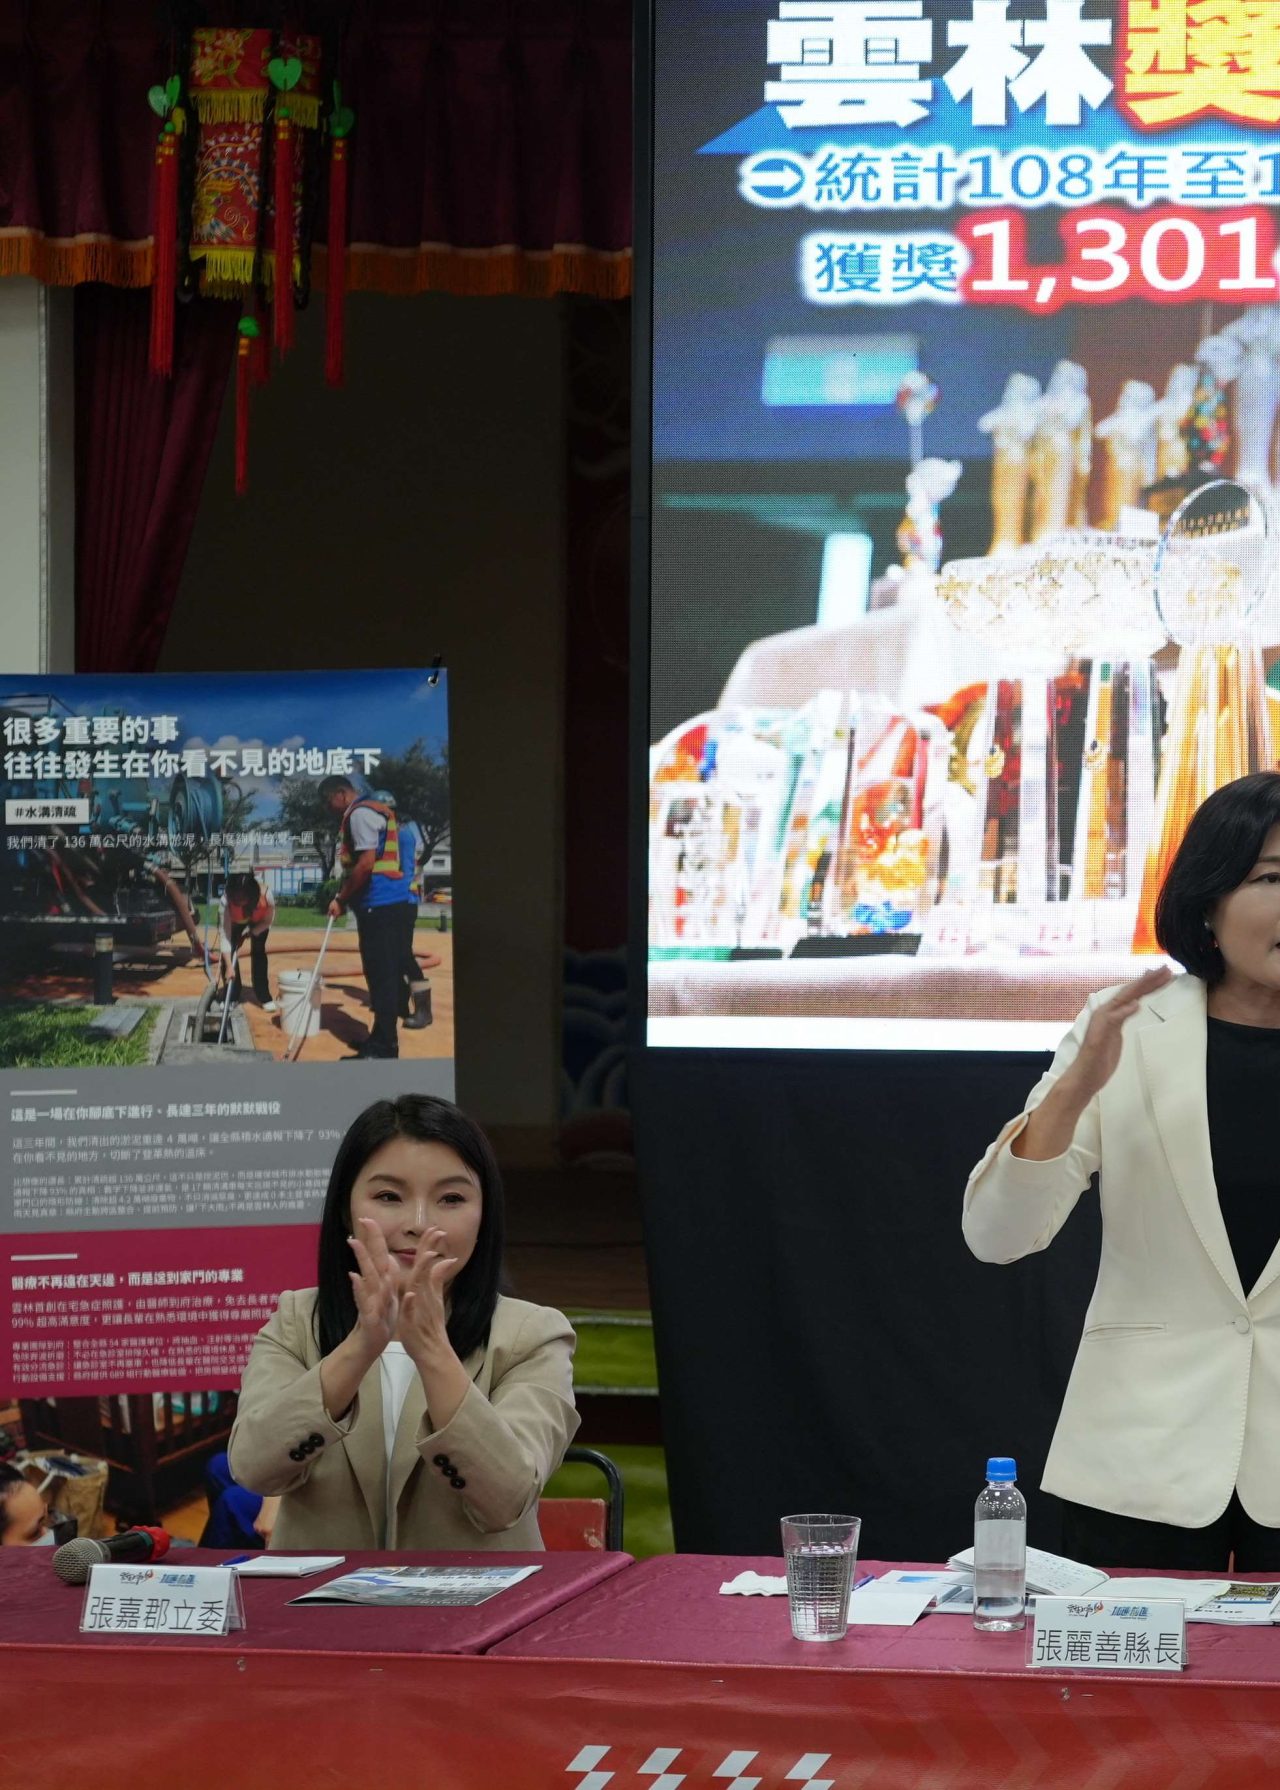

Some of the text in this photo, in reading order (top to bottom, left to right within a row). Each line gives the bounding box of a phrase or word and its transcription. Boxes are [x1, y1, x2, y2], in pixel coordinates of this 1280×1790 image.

[3, 716, 180, 746] 很多重要的事
[3, 748, 382, 780] 往往發生在你看不見的地底下
[15, 805, 78, 819] #水溝清疏
[7, 834, 59, 850] 我們清了
[64, 835, 86, 849] 136
[11, 1268, 245, 1290] 醫療不再遠在天邊，而是送到家門的專業
[88, 1596, 225, 1632] 張嘉郡立委
[1036, 1629, 1180, 1665] 張麗善縣長
